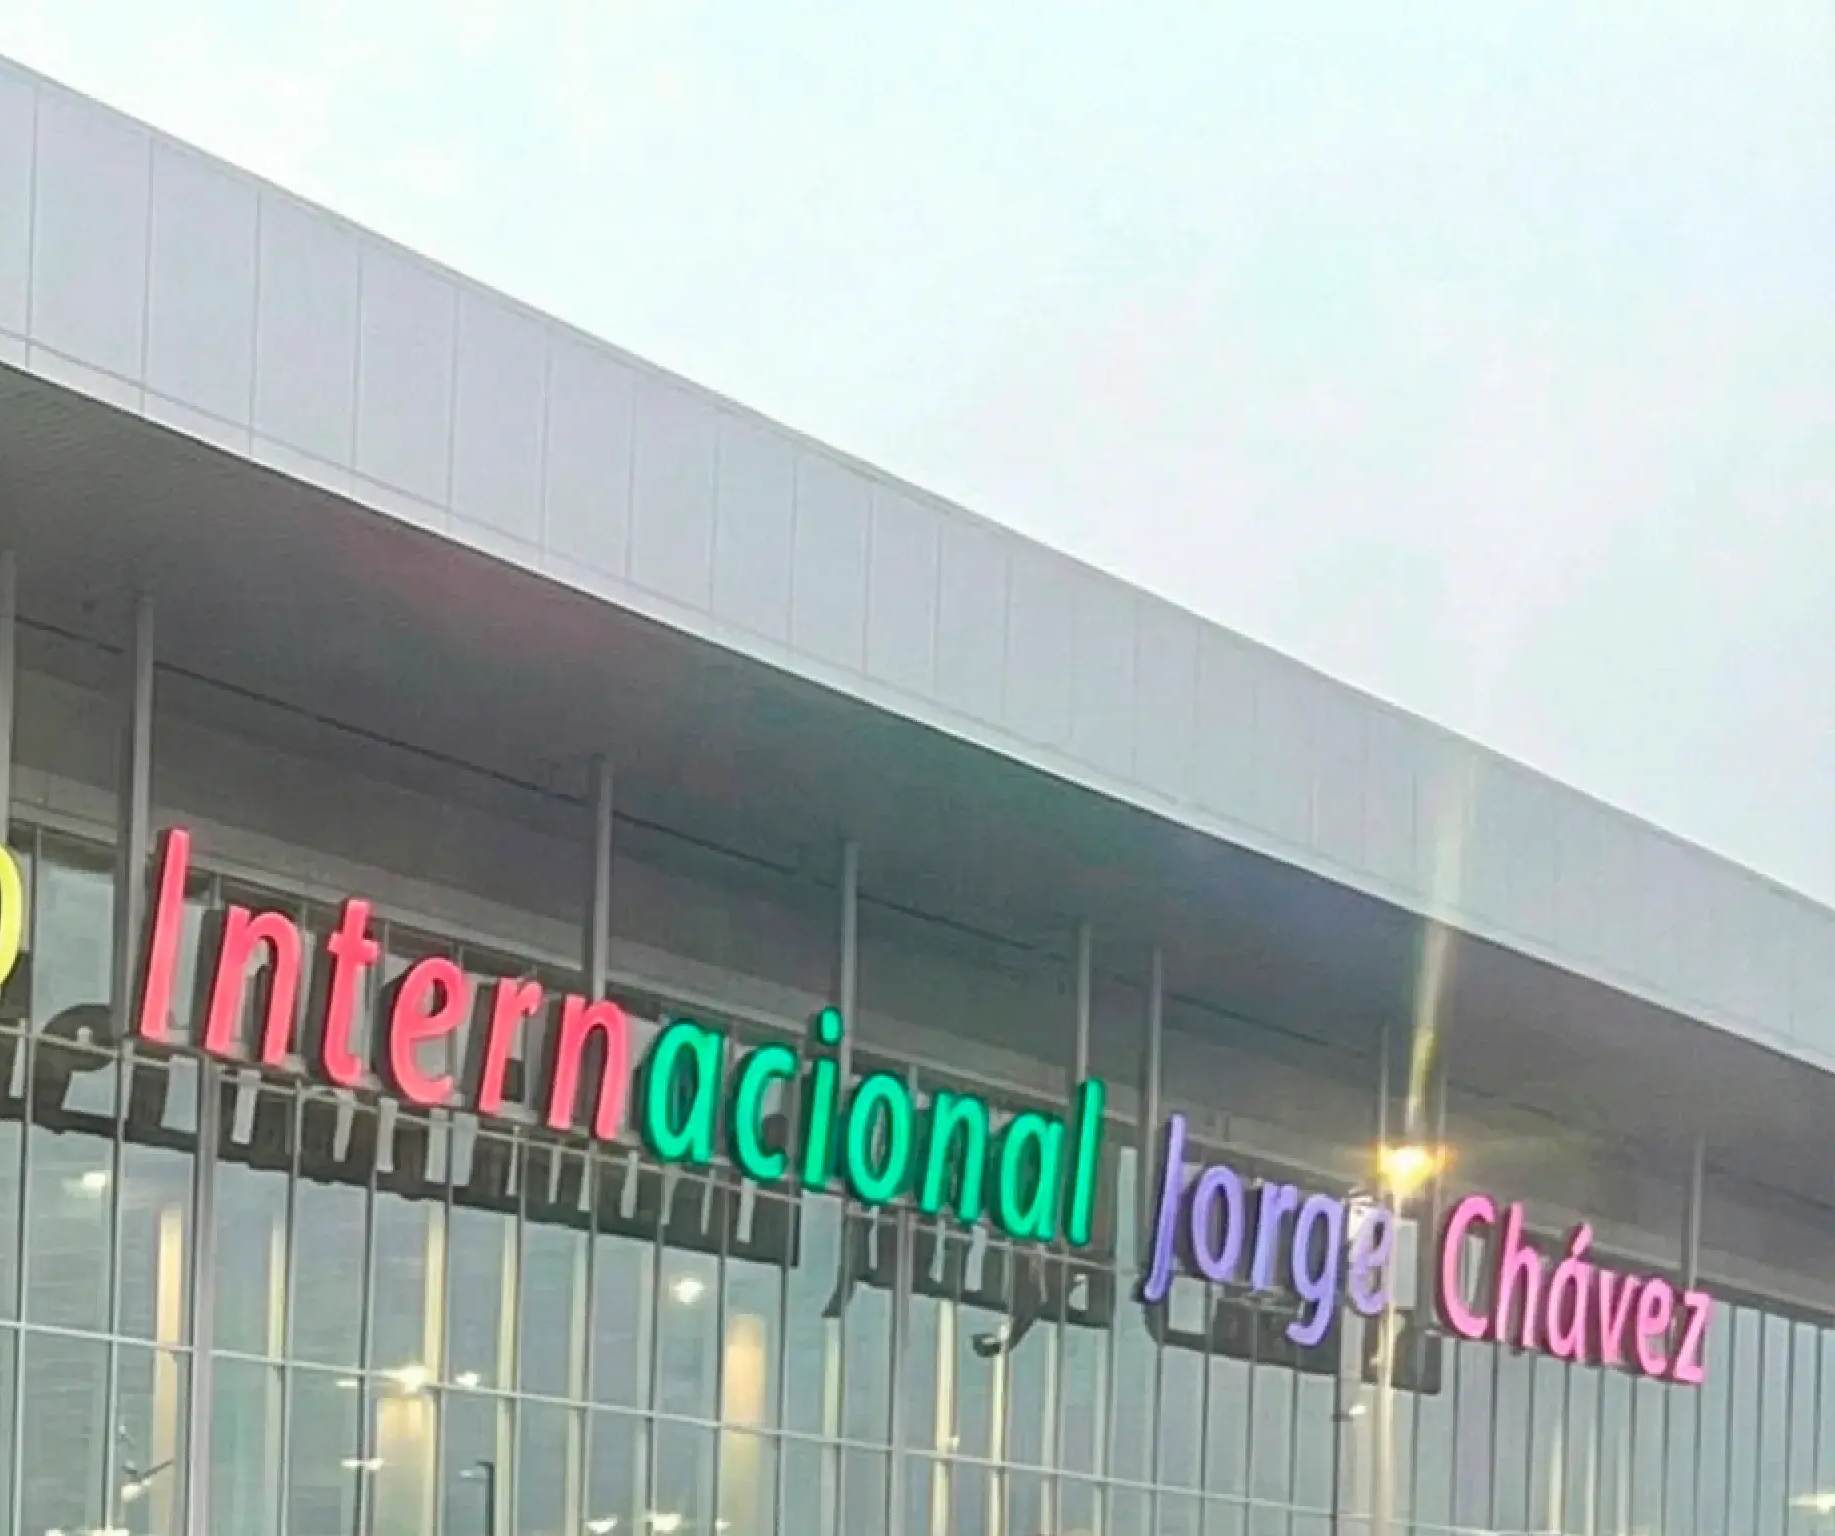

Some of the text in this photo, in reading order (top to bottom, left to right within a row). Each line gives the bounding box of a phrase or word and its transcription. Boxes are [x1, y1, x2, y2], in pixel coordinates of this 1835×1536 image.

[137, 828, 1107, 1248] Internacional
[1142, 1112, 1395, 1348] Jorge
[1437, 1193, 1715, 1387] Chávez
